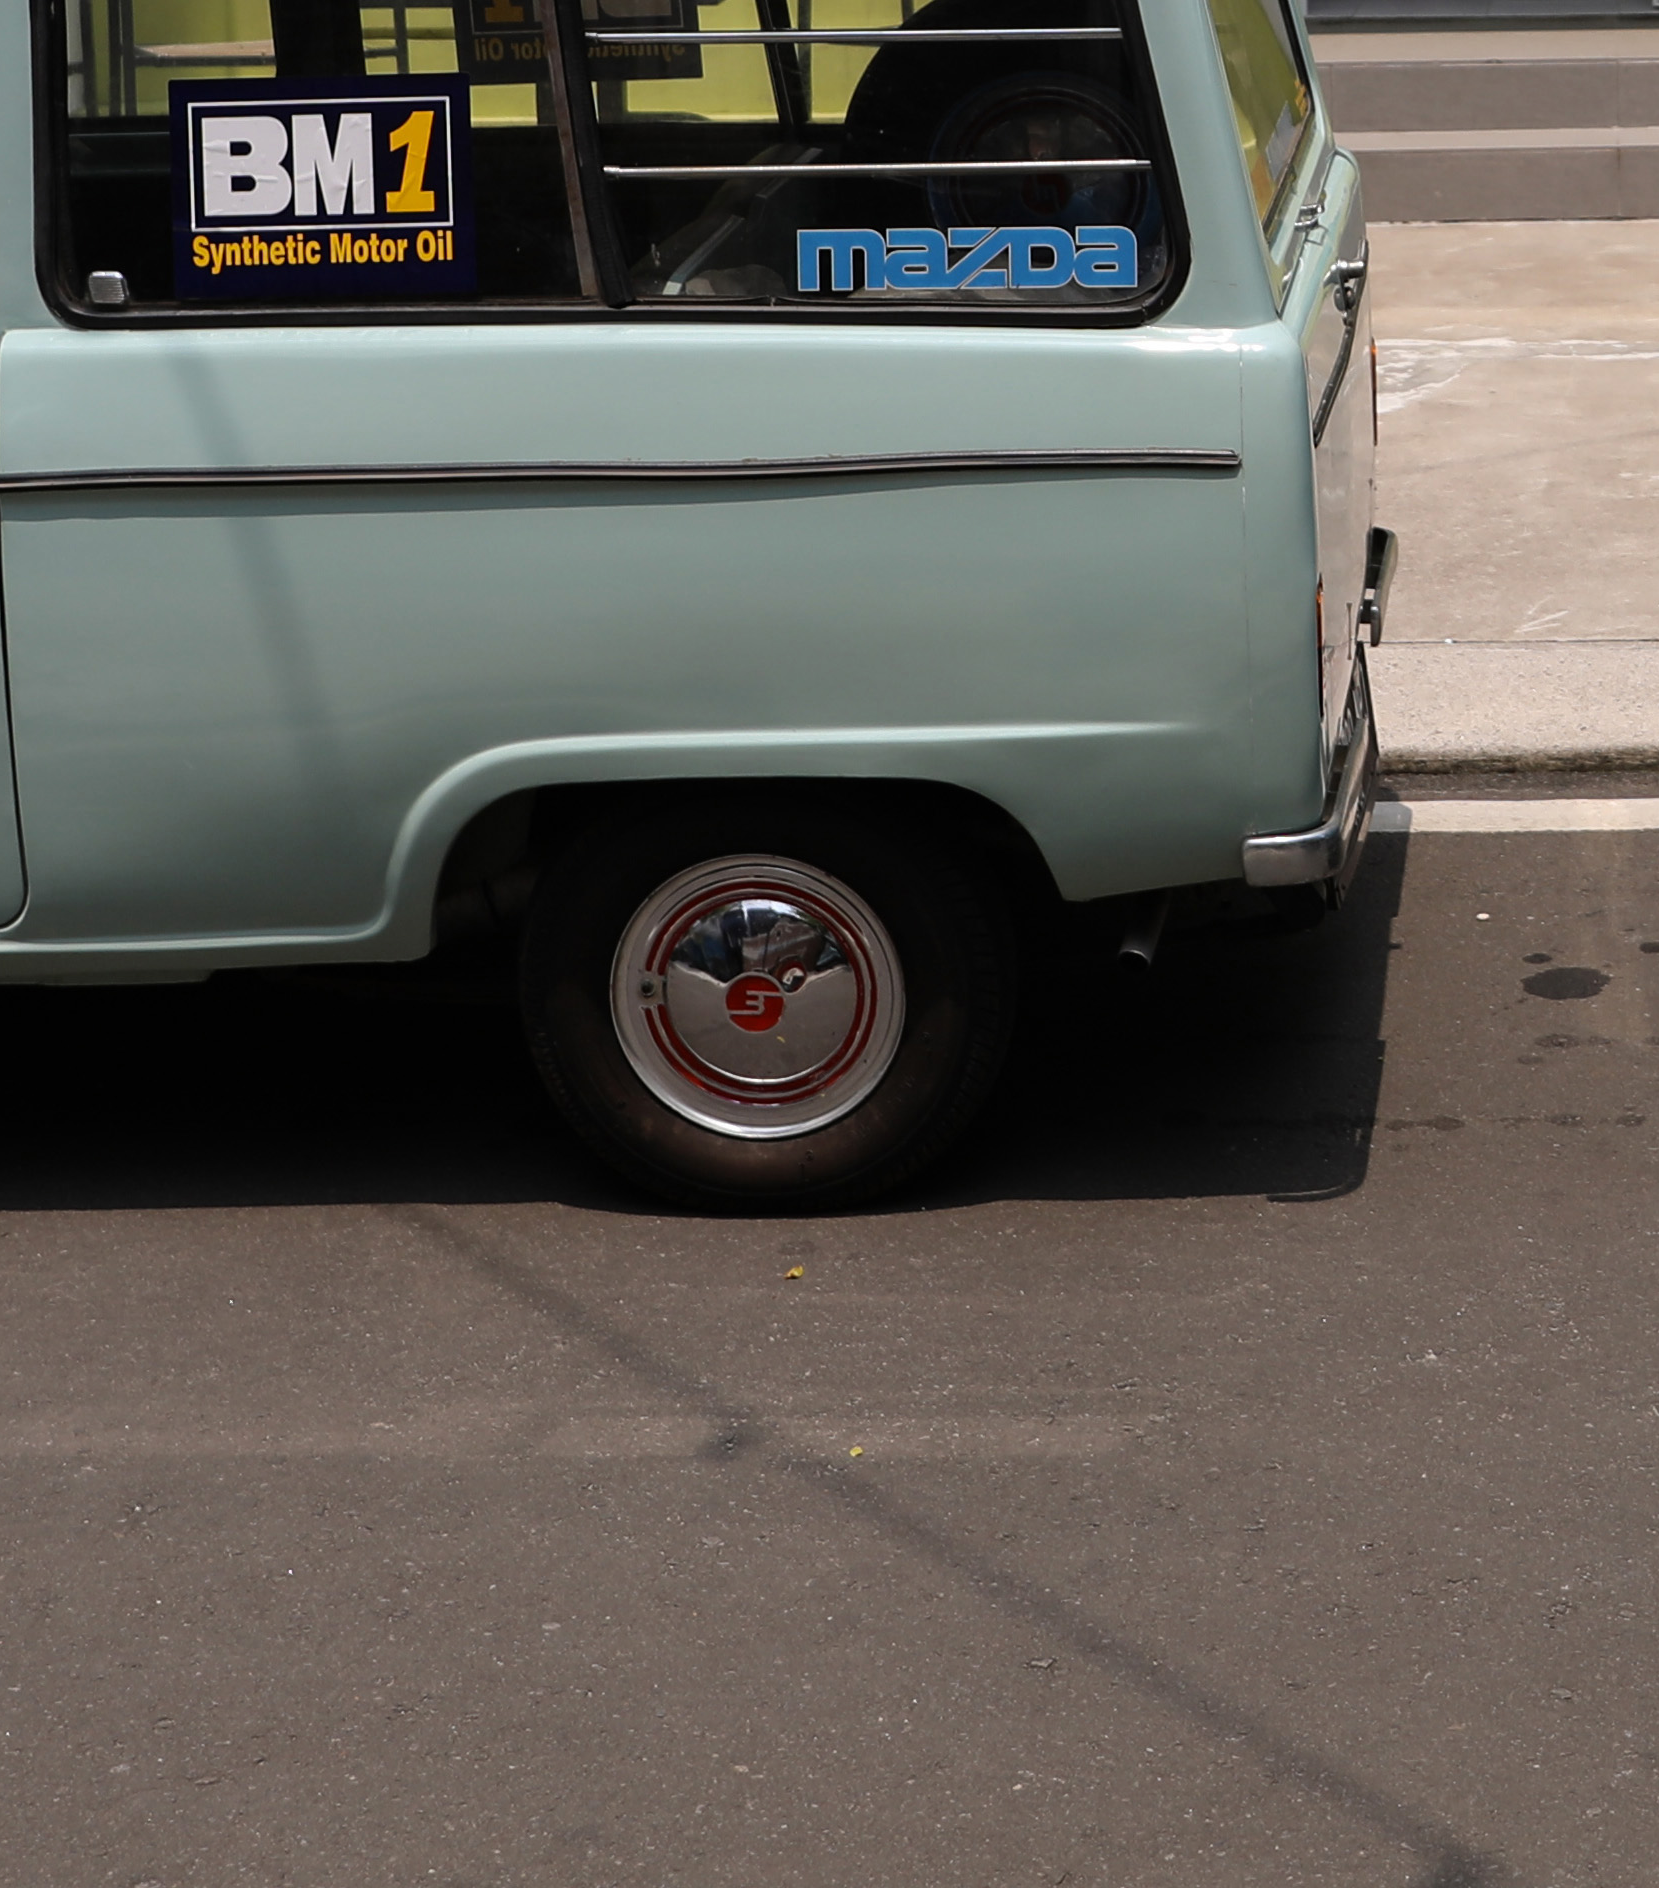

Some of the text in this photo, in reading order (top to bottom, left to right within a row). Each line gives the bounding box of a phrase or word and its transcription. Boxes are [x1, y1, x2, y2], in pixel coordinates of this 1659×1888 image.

[201, 110, 436, 218] BM1
[192, 231, 453, 275] Synthetic Motor Oil
